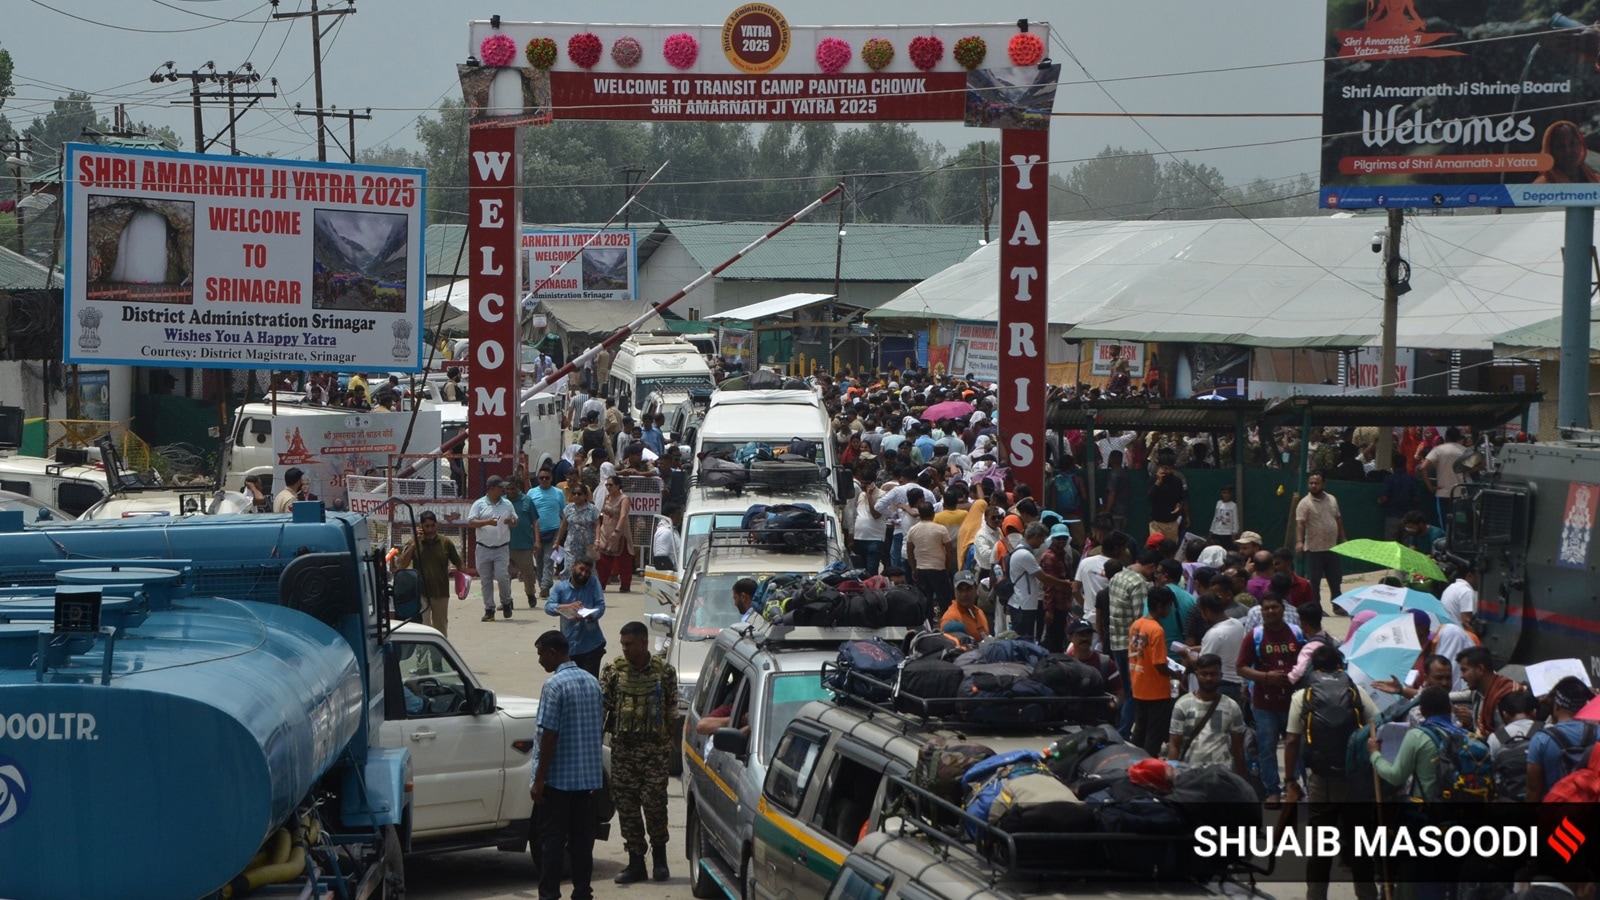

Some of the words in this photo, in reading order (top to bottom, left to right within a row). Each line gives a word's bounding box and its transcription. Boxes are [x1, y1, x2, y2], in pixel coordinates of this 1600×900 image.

[732, 5, 780, 22] Administration
[741, 25, 772, 37] YATRA
[742, 39, 770, 52] 2025
[1343, 37, 1362, 47] Shri
[1365, 35, 1410, 46] Amarnath
[1413, 35, 1422, 44] Ji
[1354, 46, 1379, 56] Yatra
[594, 79, 667, 94] WELCOME
[672, 80, 690, 95] TO
[694, 80, 757, 95] TRANSIT
[761, 79, 803, 94] CAMP
[808, 79, 867, 94] PANTHA
[871, 78, 926, 94] CHOWK
[1342, 85, 1371, 99] Shri
[1373, 83, 1452, 98] Amarnath
[1455, 82, 1468, 96] Ji
[1470, 81, 1521, 95] Shrine
[1523, 80, 1570, 94] Board
[651, 99, 681, 114] SHRI
[686, 100, 767, 115] AMARNATH
[772, 99, 786, 114] JI
[792, 99, 835, 114] YATRA
[840, 99, 877, 114] 2025
[1362, 104, 1536, 148] Welcomes
[1354, 159, 1397, 172] Pilgrims
[1399, 158, 1410, 169] of
[1412, 158, 1432, 169] Shri
[1435, 157, 1493, 168] Amarnath
[1495, 157, 1505, 168] Ji
[1507, 157, 1538, 168] Yatra
[79, 155, 136, 190] SHRI
[141, 160, 265, 199] AMARNATH
[270, 169, 287, 200] JI
[292, 171, 357, 204] YATRA
[361, 175, 415, 208] 2025
[1522, 190, 1597, 203] Department
[208, 206, 301, 235] WELCOME
[522, 235, 559, 247] ARNATH
[562, 234, 569, 247] JI
[604, 233, 630, 246] 2025
[243, 243, 267, 269] TO
[535, 250, 576, 261] WELCOME
[550, 265, 562, 275] TO
[206, 276, 302, 305] SRINAGAR
[535, 279, 577, 289] SRINAGAR
[583, 291, 613, 300] Srinagar
[472, 151, 511, 463] WELCOME
[1007, 155, 1041, 467] YATRIS
[122, 305, 185, 325] District
[189, 309, 308, 329] Administration
[311, 313, 376, 334] Srinagar
[164, 328, 212, 343] Wishes
[215, 330, 240, 343] You
[243, 331, 254, 344] A
[257, 331, 299, 347] Happy
[302, 332, 337, 346] Yatra
[141, 345, 197, 361] Courtesy:
[200, 347, 242, 360] District
[246, 348, 307, 362] Magistrate,
[310, 350, 357, 364] Srinagar
[1394, 364, 1407, 389] SK
[629, 497, 660, 512] NCRPF
